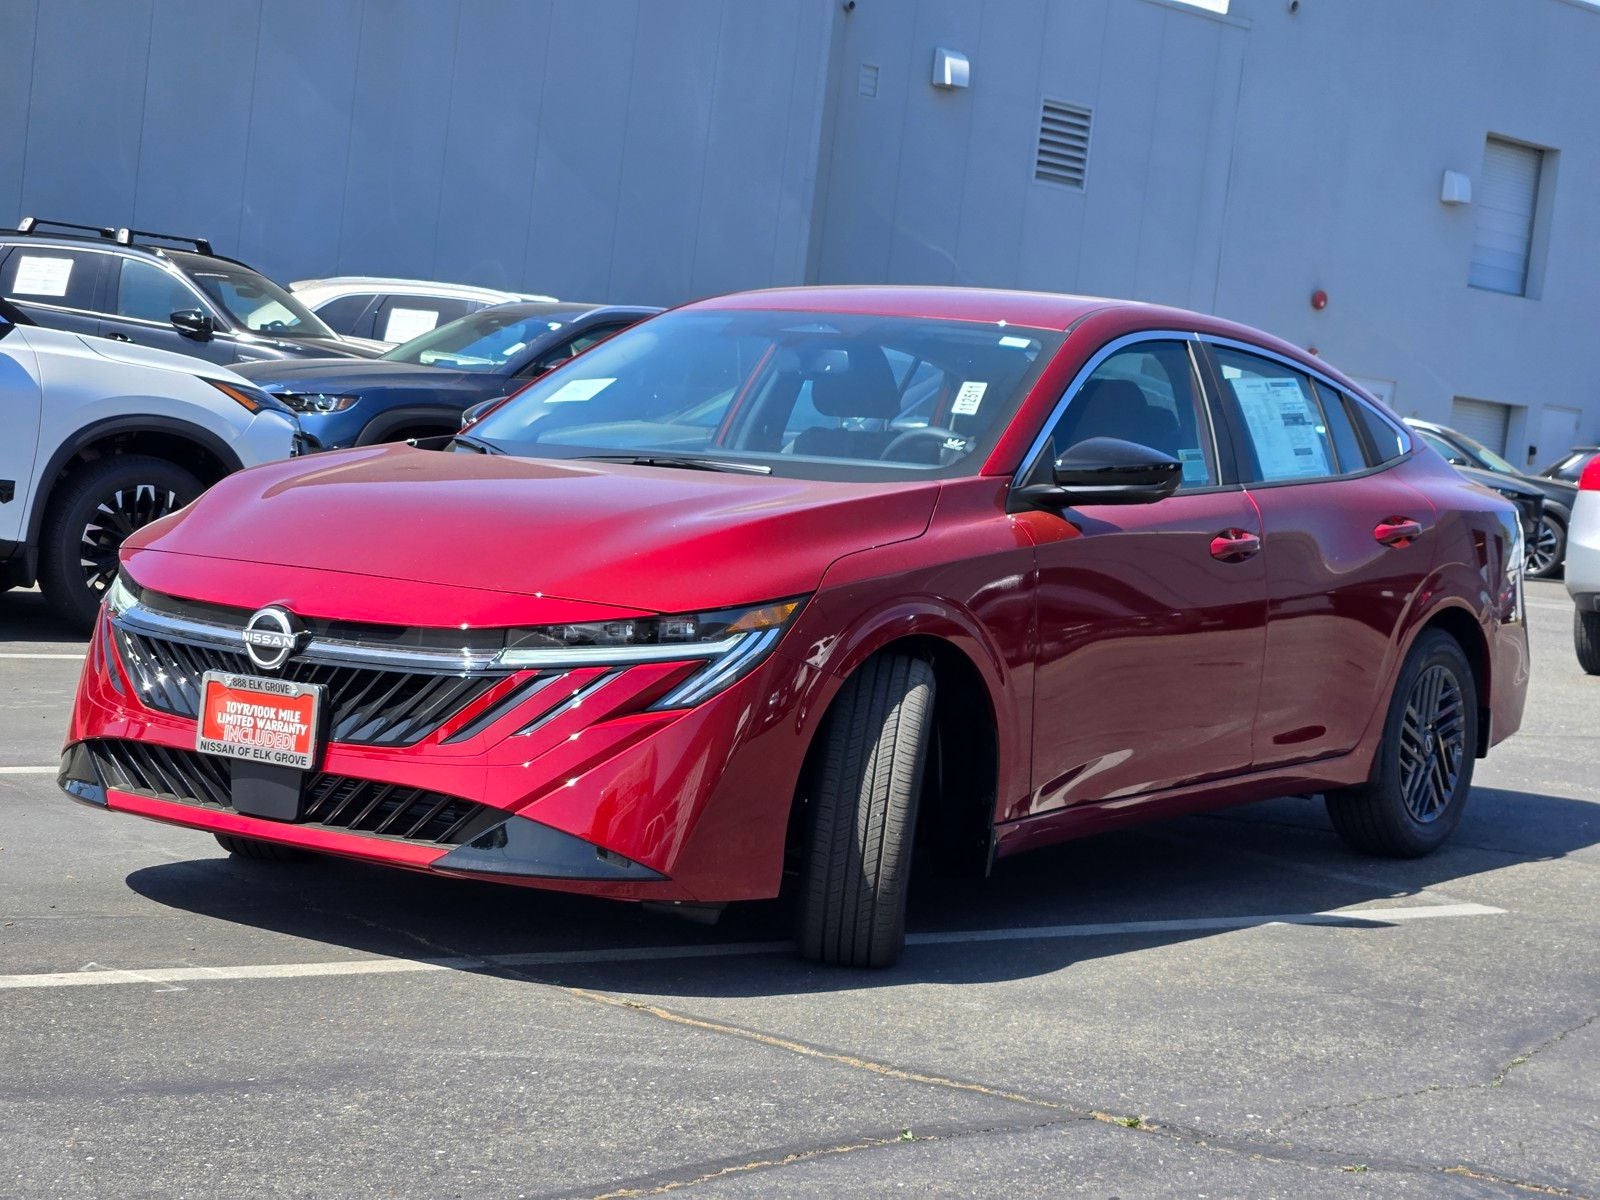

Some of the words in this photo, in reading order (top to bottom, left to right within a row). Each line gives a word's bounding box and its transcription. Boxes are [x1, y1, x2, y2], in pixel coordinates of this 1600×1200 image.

[242, 631, 295, 648] NISSAN
[232, 677, 247, 689] 888
[249, 679, 263, 690] ELK
[265, 682, 291, 695] GROVE
[226, 701, 277, 719] 10YR/100K
[278, 708, 301, 722] MILE
[216, 711, 255, 727] LIMITED
[256, 717, 308, 736] WARRANTY
[223, 724, 297, 751] INCLUDED!
[200, 740, 235, 755] NISSAN
[237, 746, 251, 757] OF
[253, 748, 272, 761] ELK
[274, 752, 308, 766] GROVE
